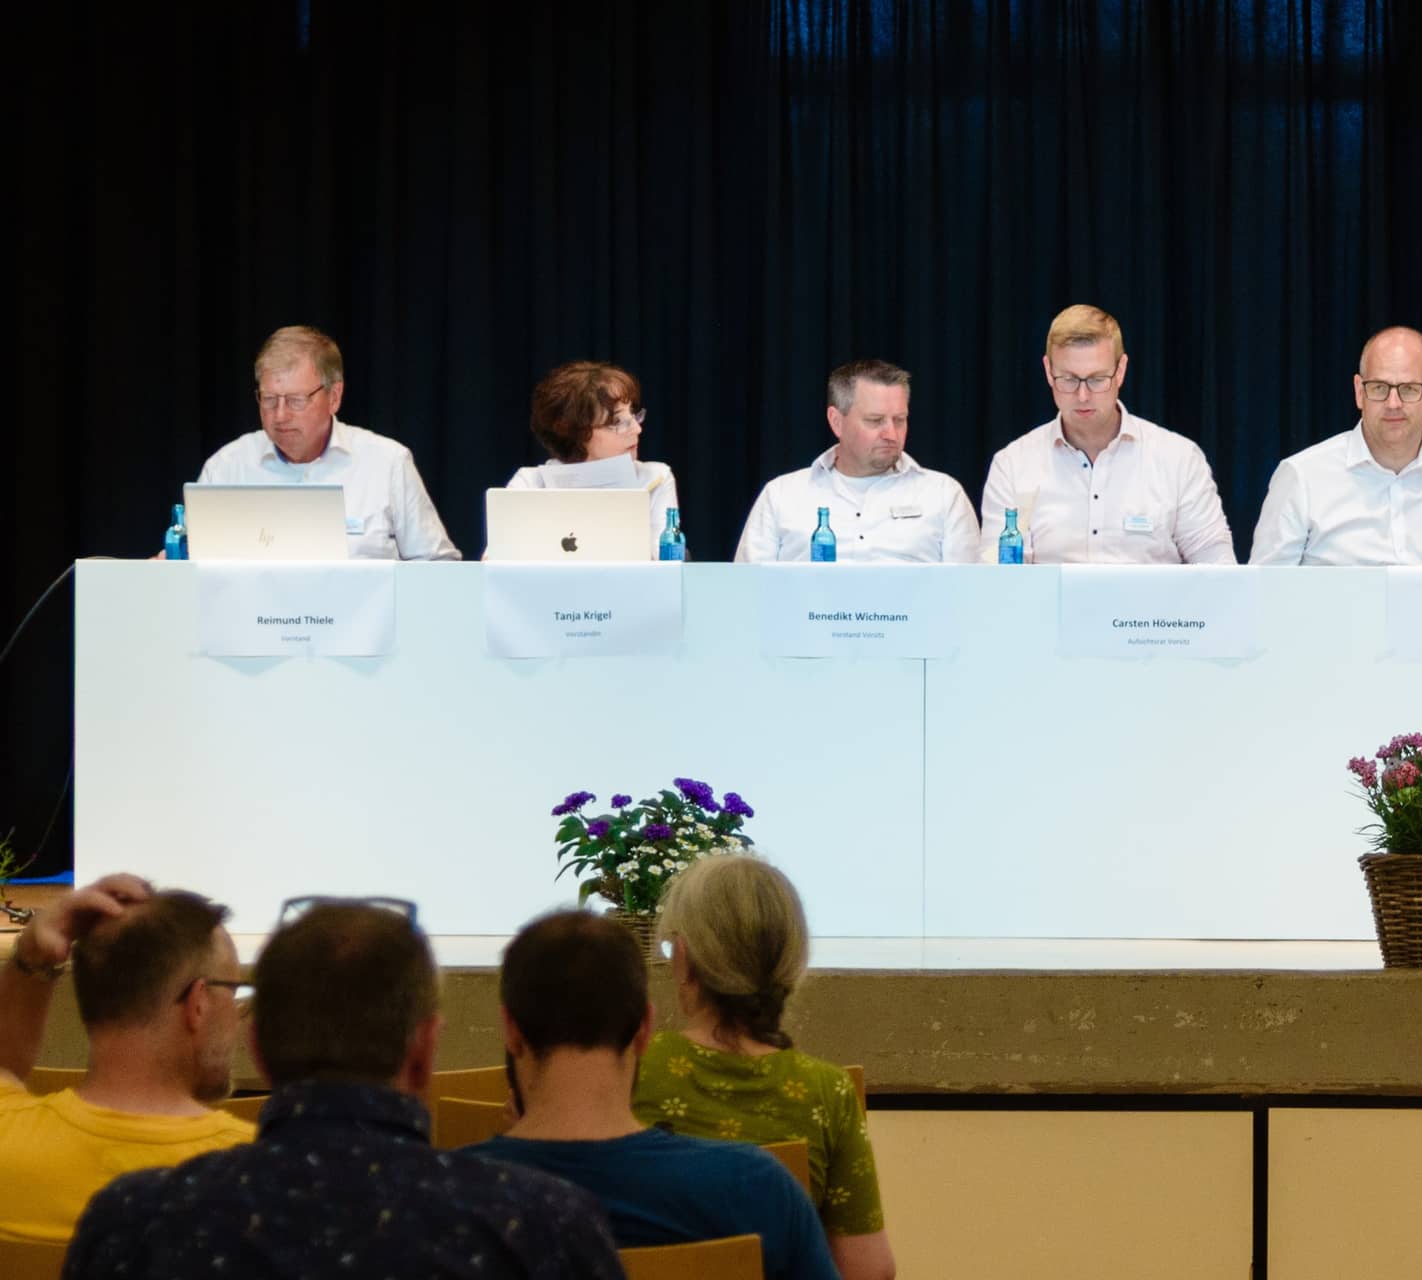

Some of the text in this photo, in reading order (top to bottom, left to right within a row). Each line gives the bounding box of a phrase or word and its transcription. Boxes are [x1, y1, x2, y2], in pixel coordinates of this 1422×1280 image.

[257, 615, 335, 625] Reimund Thiele
[554, 609, 612, 622] Tanja Krigel
[808, 611, 909, 622] Benedikt Wichmann
[1112, 618, 1206, 630] Carsten Hövekamp
